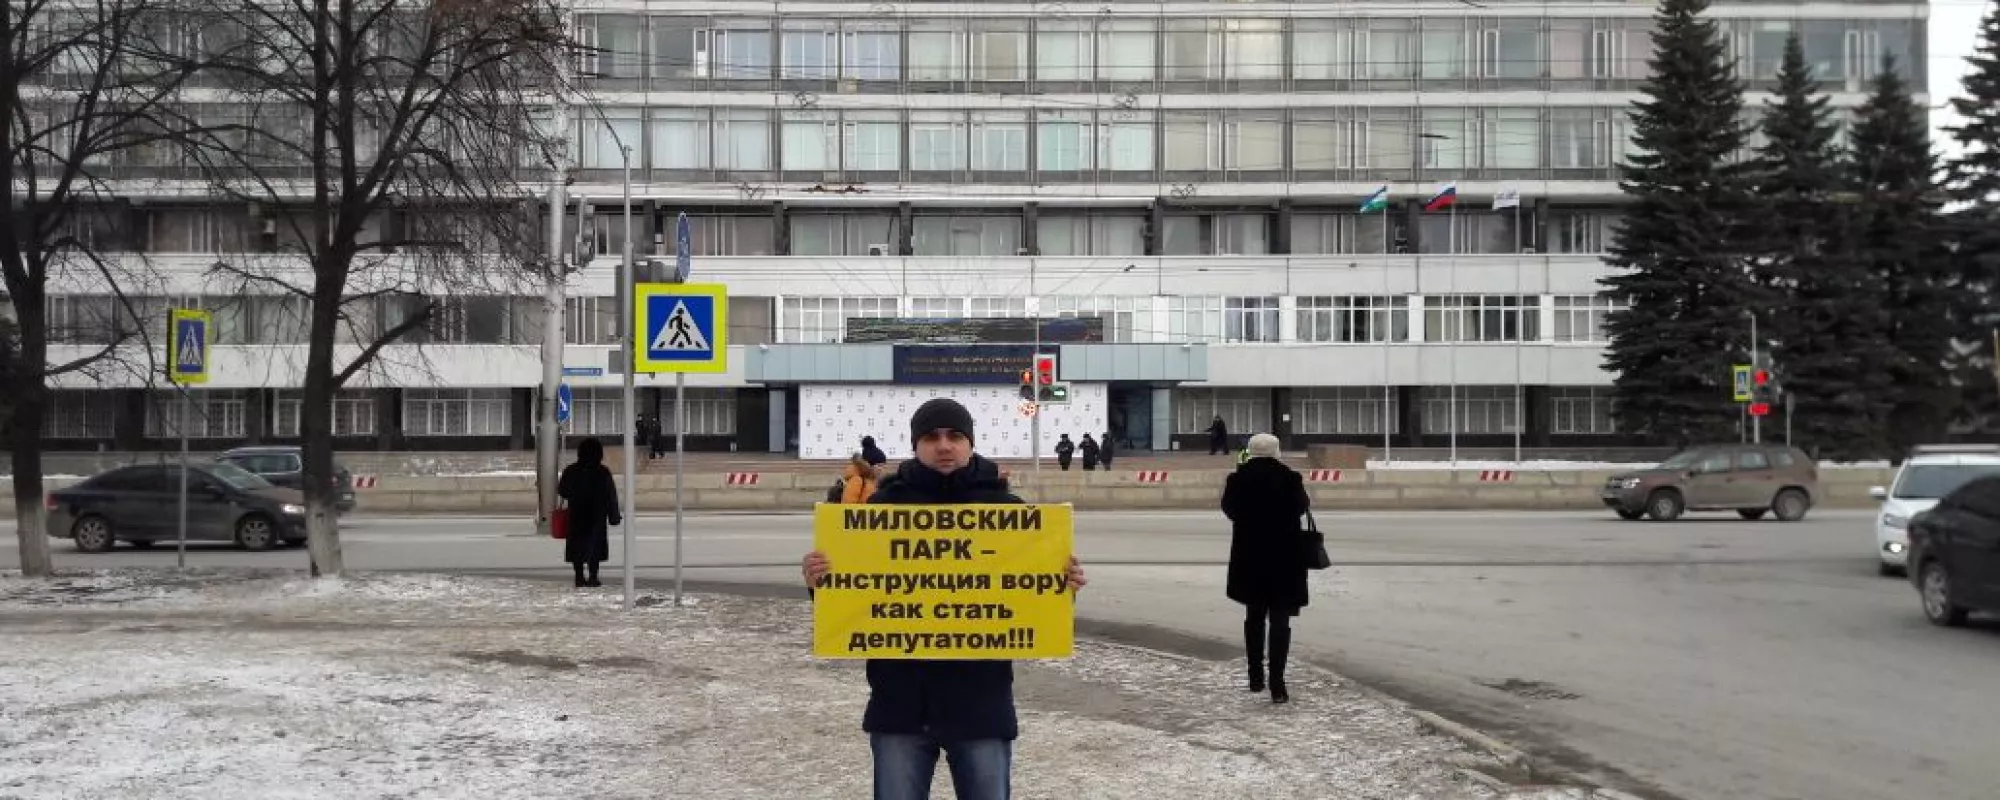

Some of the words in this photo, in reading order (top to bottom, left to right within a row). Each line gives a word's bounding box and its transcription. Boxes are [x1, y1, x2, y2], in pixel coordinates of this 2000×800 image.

[843, 505, 1042, 530] МИЛОВСКИЙ
[890, 538, 972, 560] ПАРК
[815, 572, 991, 594] инструкция
[1001, 572, 1069, 594] вору
[871, 602, 923, 619] как
[933, 602, 1014, 619] стать
[848, 628, 1034, 653] депутатом!!!
